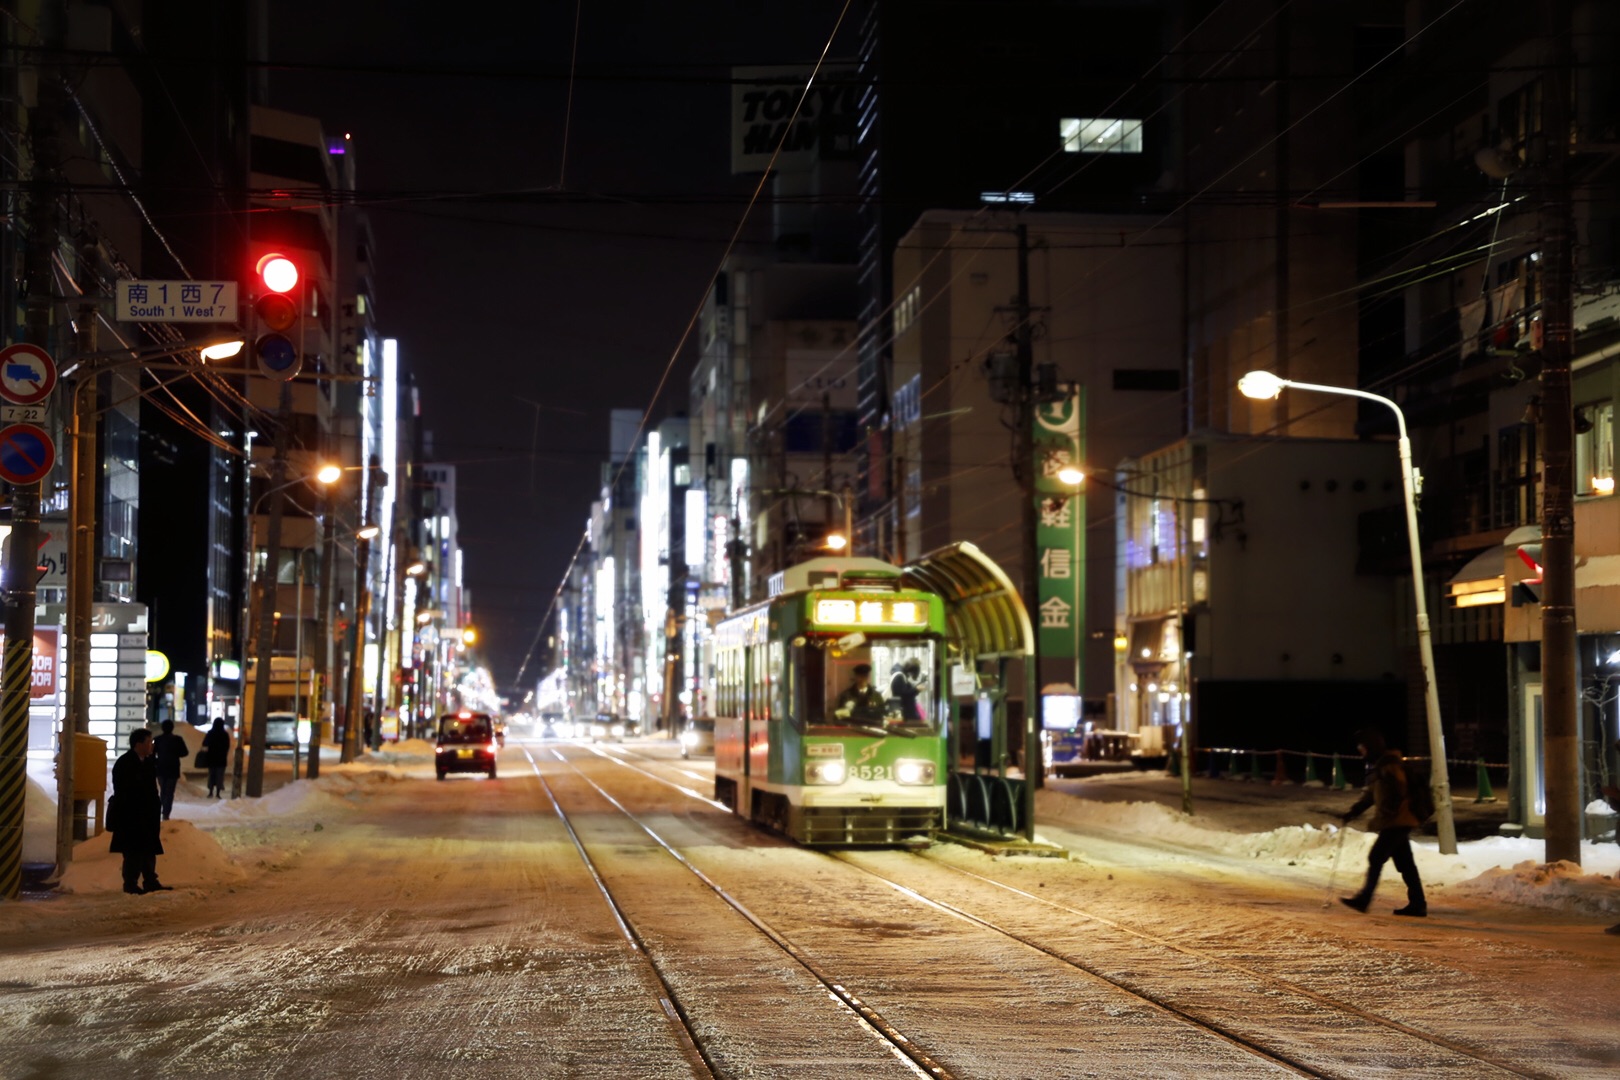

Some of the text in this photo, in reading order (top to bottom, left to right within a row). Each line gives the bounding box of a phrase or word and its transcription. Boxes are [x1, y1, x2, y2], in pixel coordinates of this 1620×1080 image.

[130, 305, 226, 317] South 1 West 7
[848, 765, 893, 780] 8521
